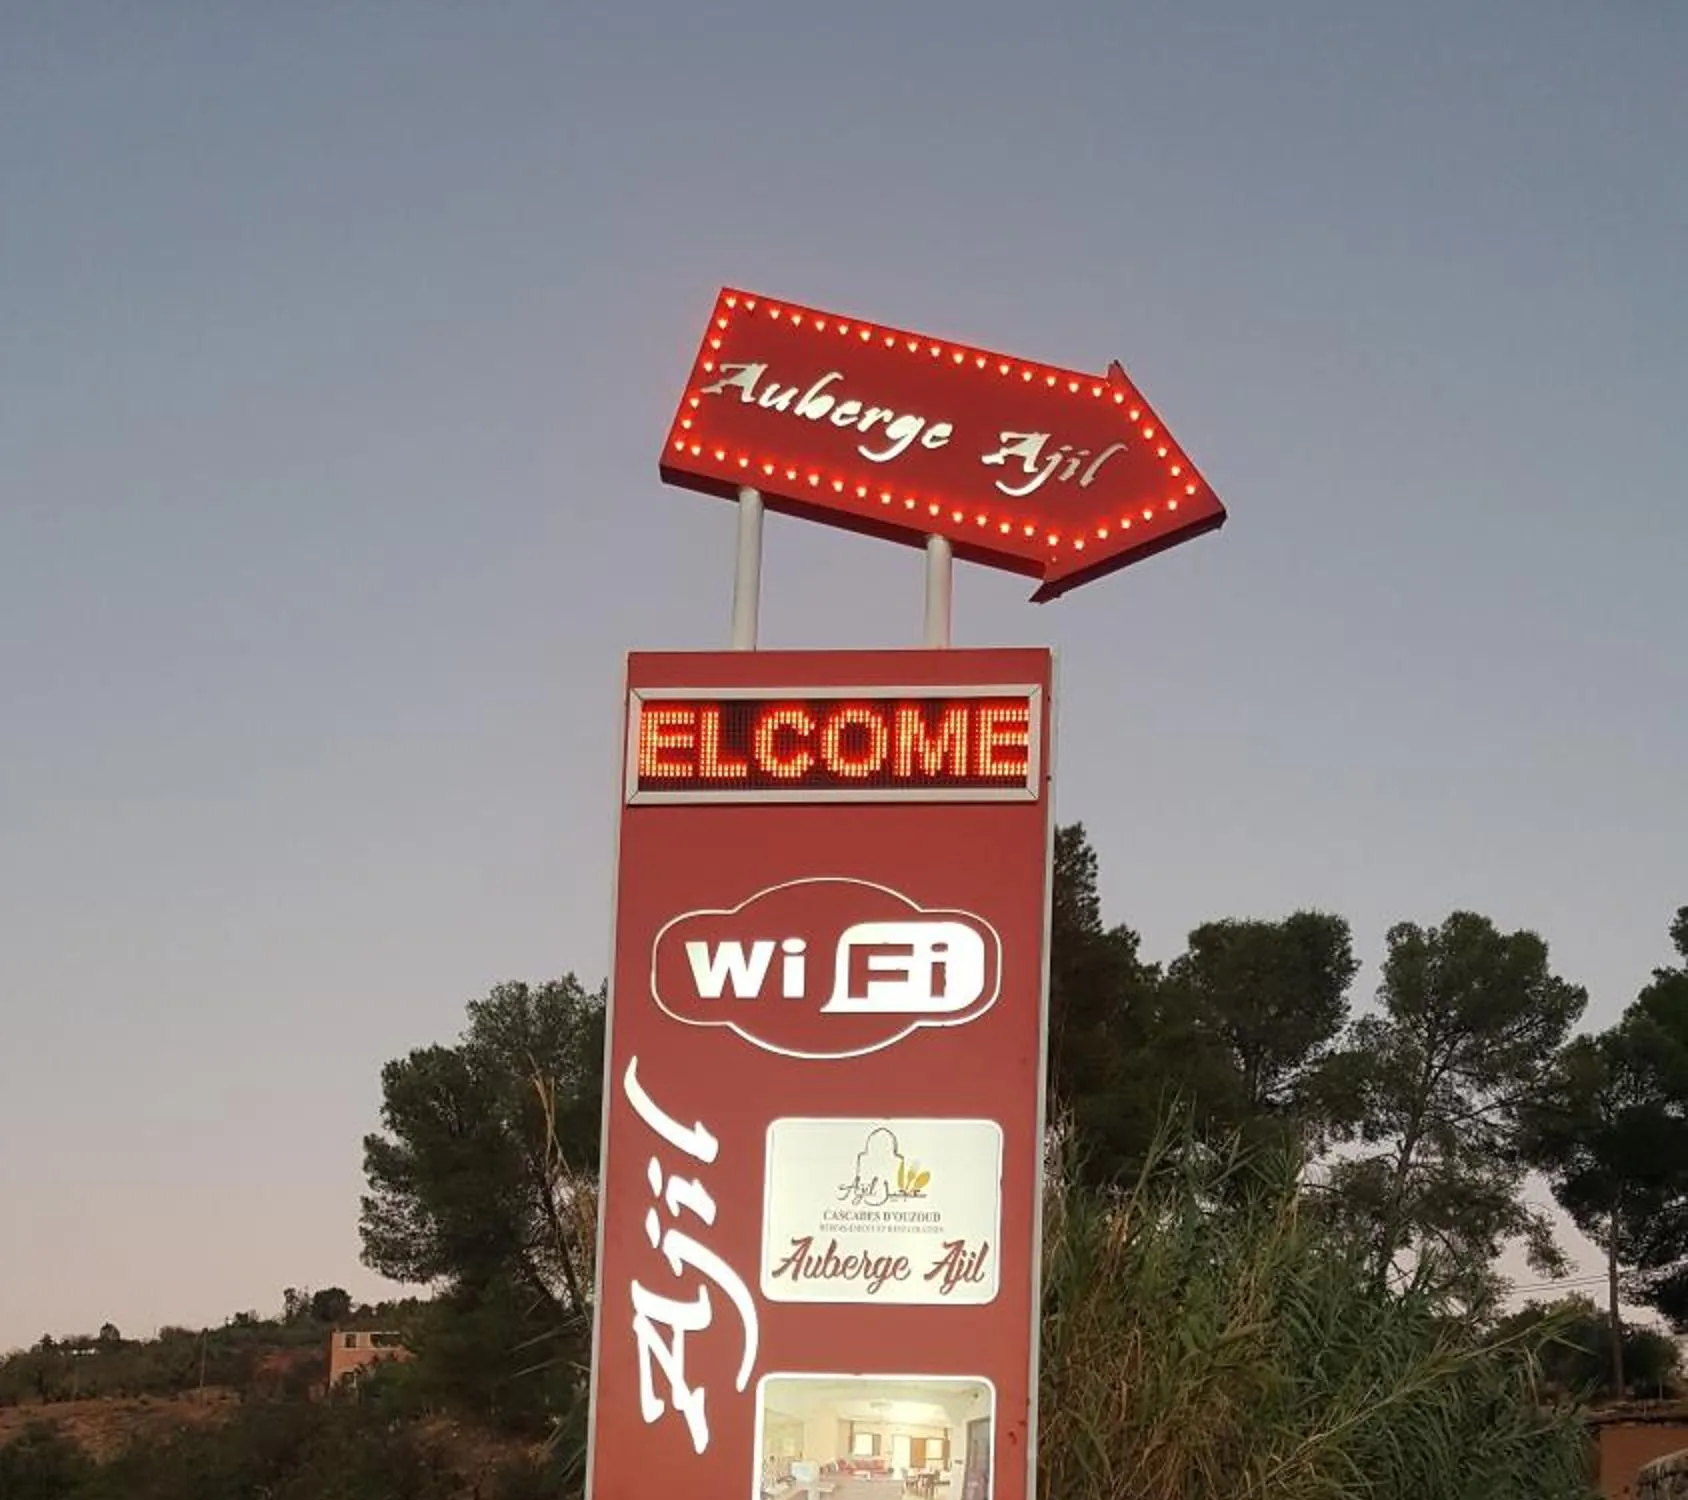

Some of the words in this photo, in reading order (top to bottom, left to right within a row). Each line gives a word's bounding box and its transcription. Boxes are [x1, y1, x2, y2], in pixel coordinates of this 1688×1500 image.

[701, 361, 954, 463] Auberge
[981, 430, 1129, 497] Ajil
[639, 707, 1030, 778] ELCOME
[623, 1055, 758, 1454] Ajil
[771, 1236, 911, 1295] Auberge
[923, 1239, 990, 1296] Ajil
